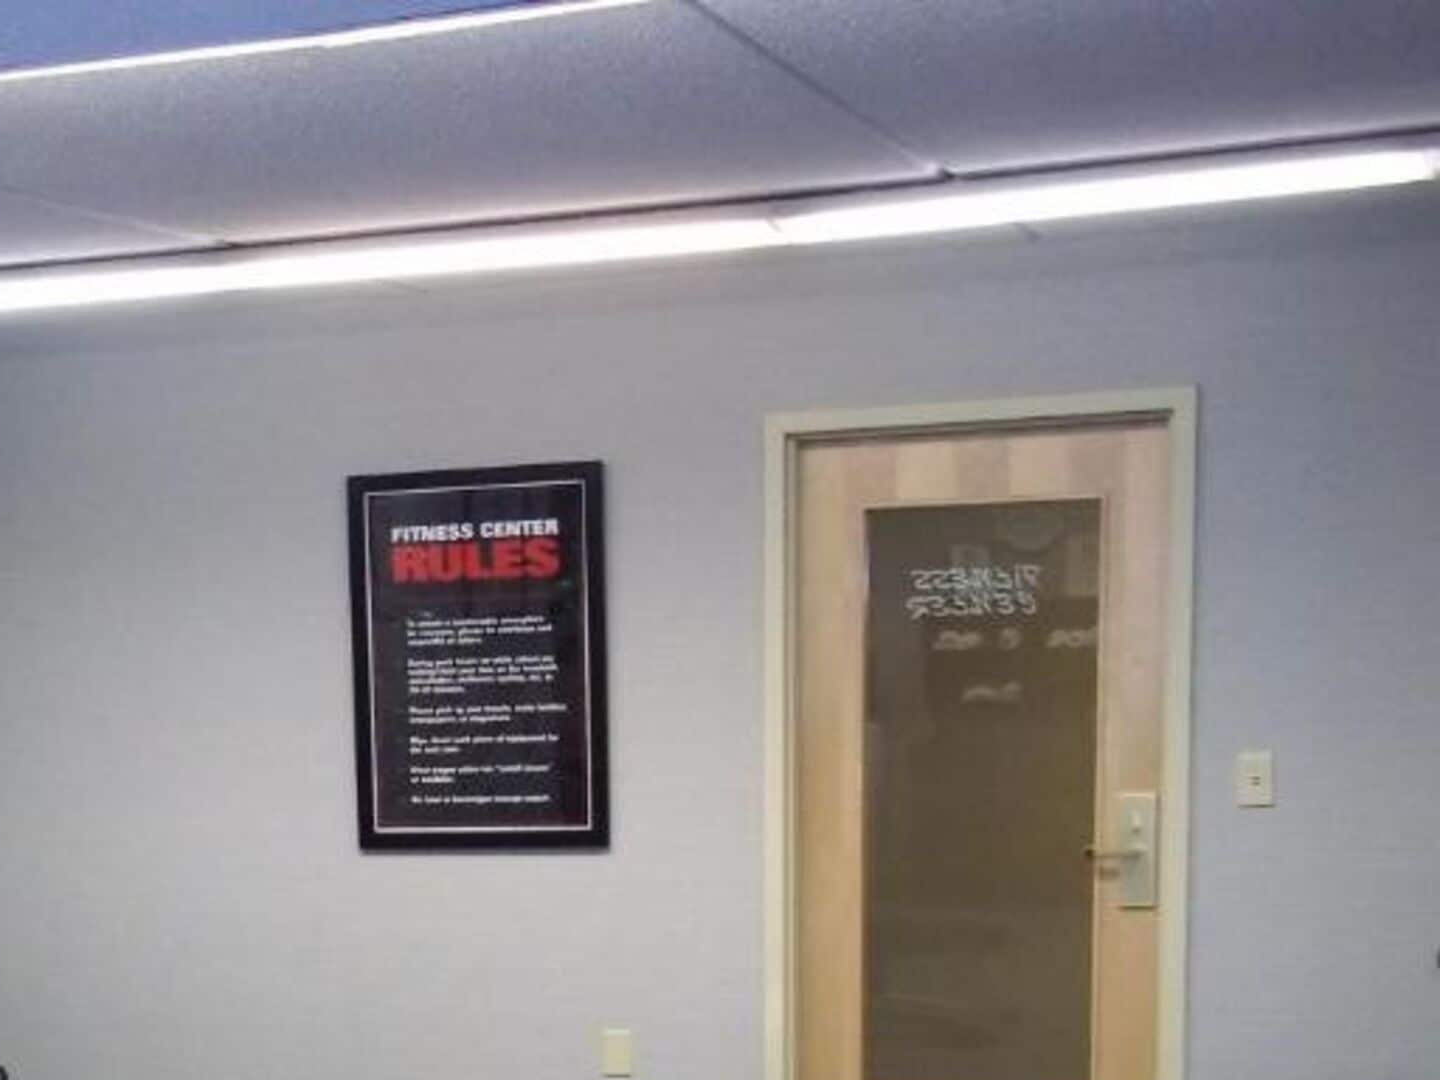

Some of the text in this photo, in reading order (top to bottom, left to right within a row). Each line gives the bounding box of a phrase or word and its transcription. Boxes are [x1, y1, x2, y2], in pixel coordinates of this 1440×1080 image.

[391, 518, 559, 543] FITNESS CENTER
[392, 539, 560, 582] RULES
